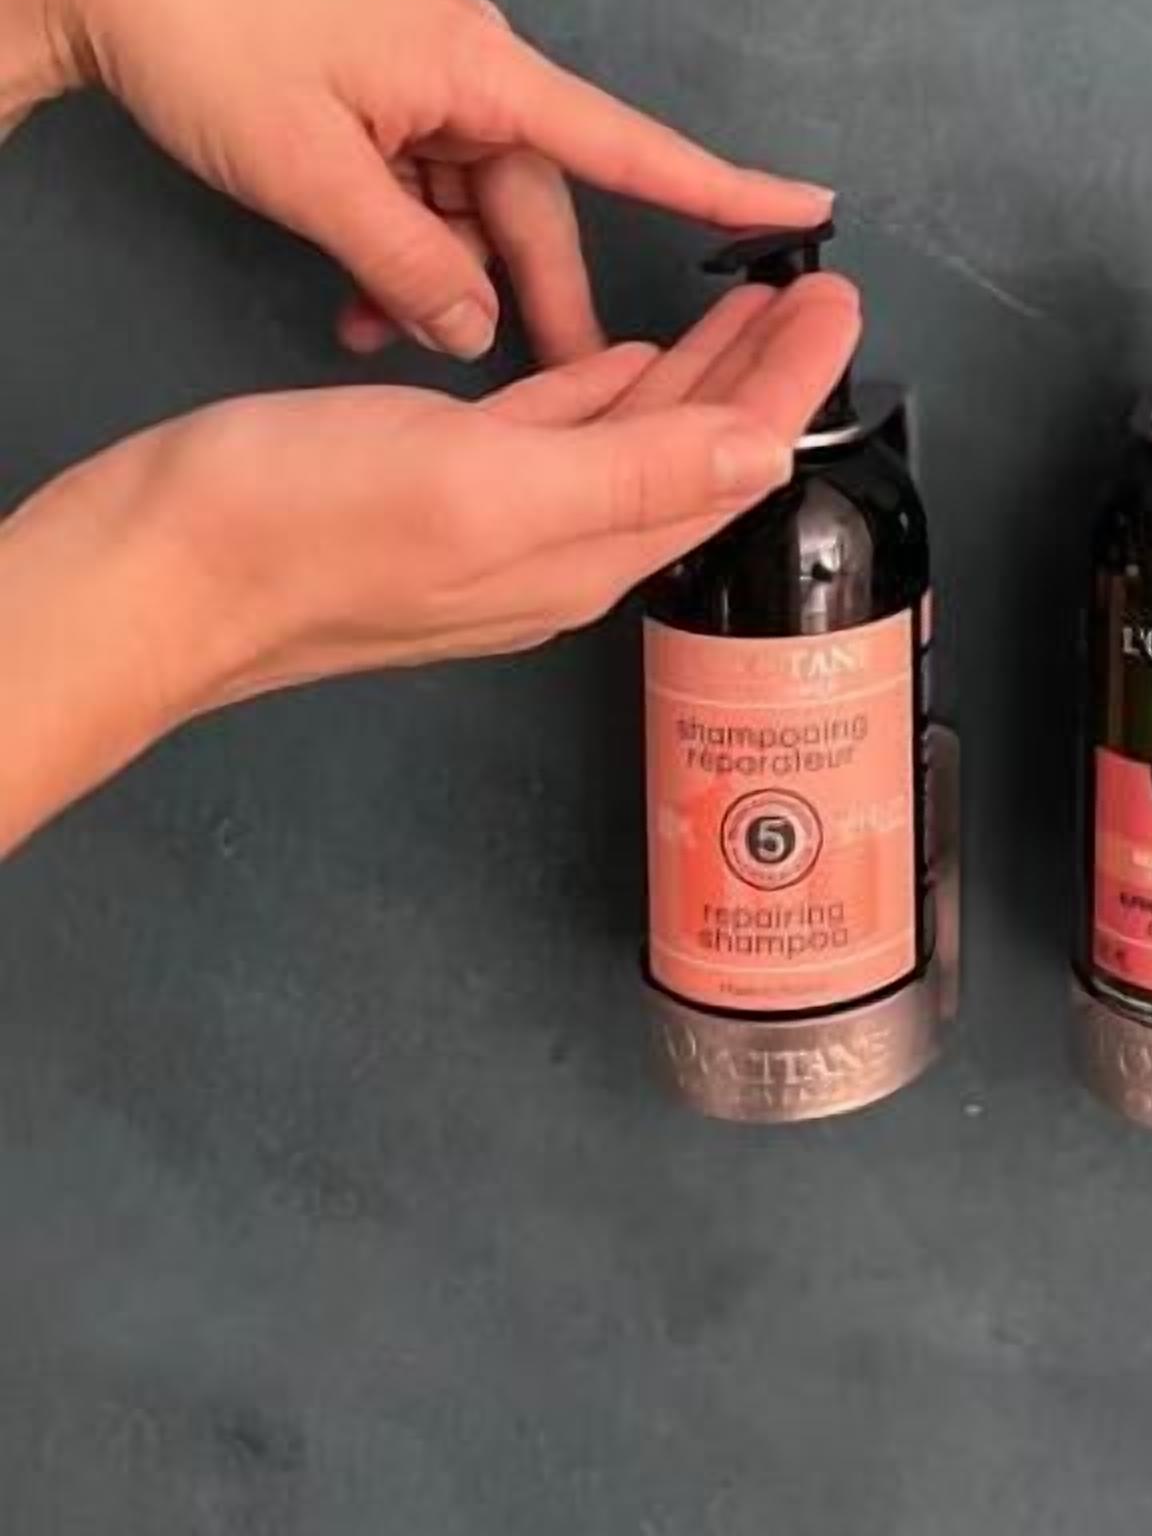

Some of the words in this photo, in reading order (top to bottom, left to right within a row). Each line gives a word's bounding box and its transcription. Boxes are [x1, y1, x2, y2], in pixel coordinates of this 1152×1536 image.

[757, 818, 787, 859] 5
[702, 901, 846, 930] repairing
[697, 926, 849, 960] shampoo
